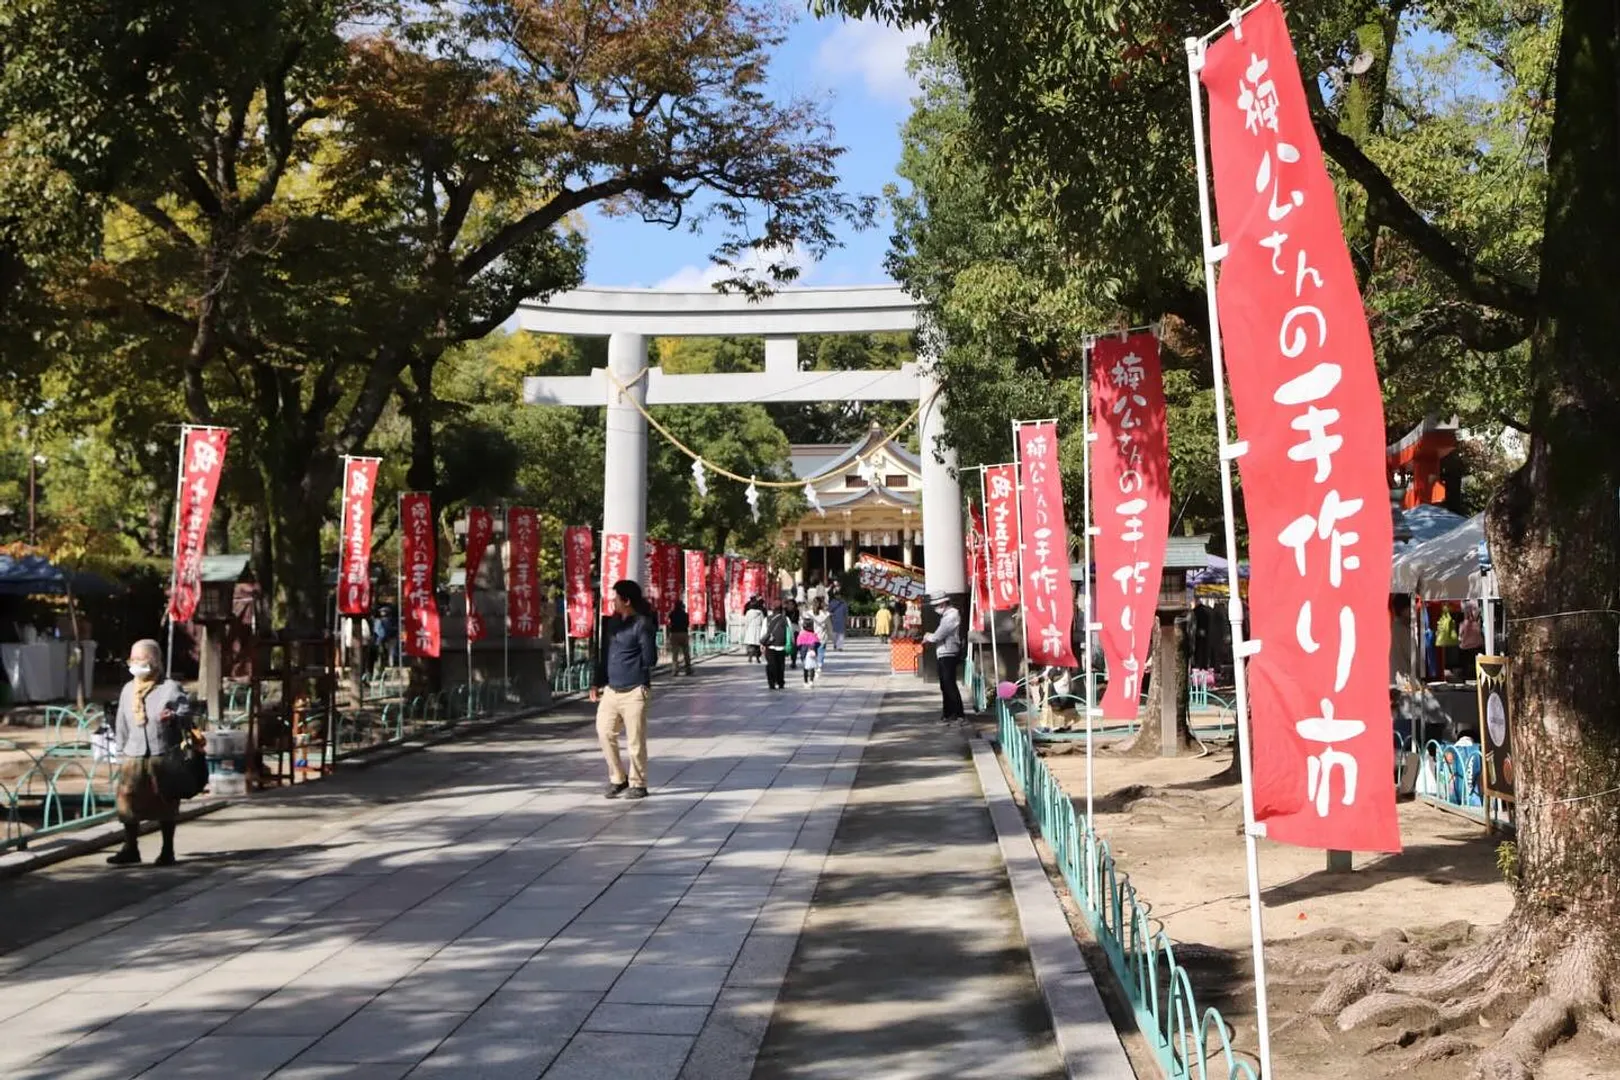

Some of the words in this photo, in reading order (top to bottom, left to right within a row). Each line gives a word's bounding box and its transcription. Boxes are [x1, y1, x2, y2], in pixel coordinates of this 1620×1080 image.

[1026, 436, 1063, 657] 楠公さんの手作り市
[1238, 52, 1365, 816] 楠公さんの手作り市
